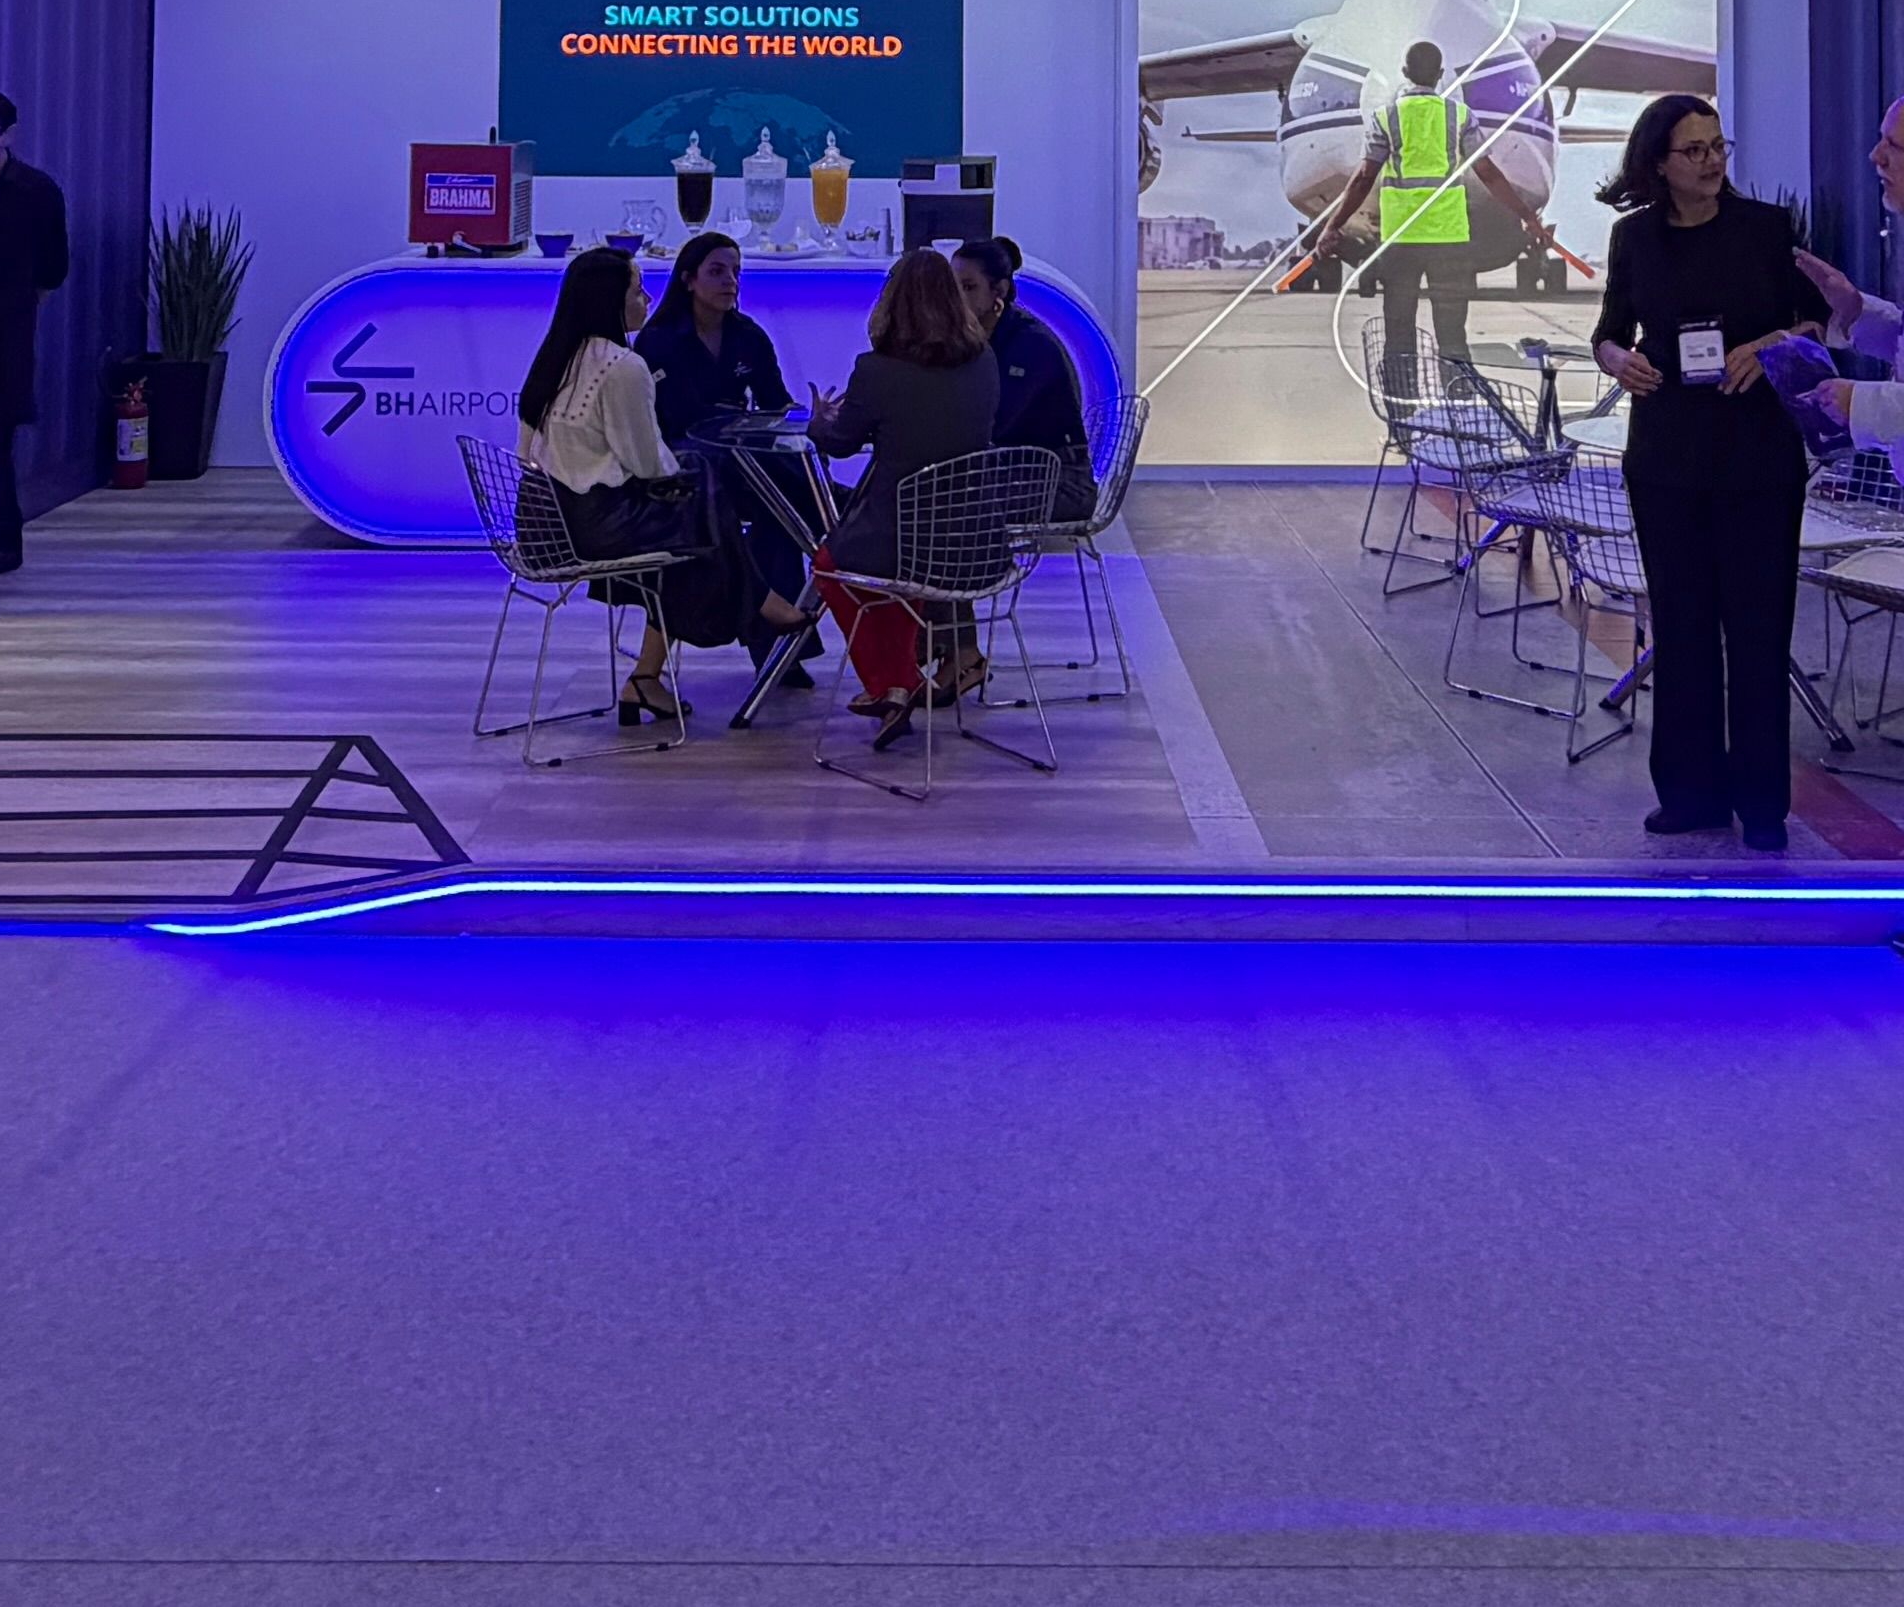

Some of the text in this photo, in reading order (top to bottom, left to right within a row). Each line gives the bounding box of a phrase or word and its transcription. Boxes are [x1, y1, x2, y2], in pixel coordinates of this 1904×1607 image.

[604, 5, 859, 27] SMART SOLUTIONS
[560, 33, 903, 57] CONNECTING THE WORLD
[429, 188, 491, 208] BRAHMA
